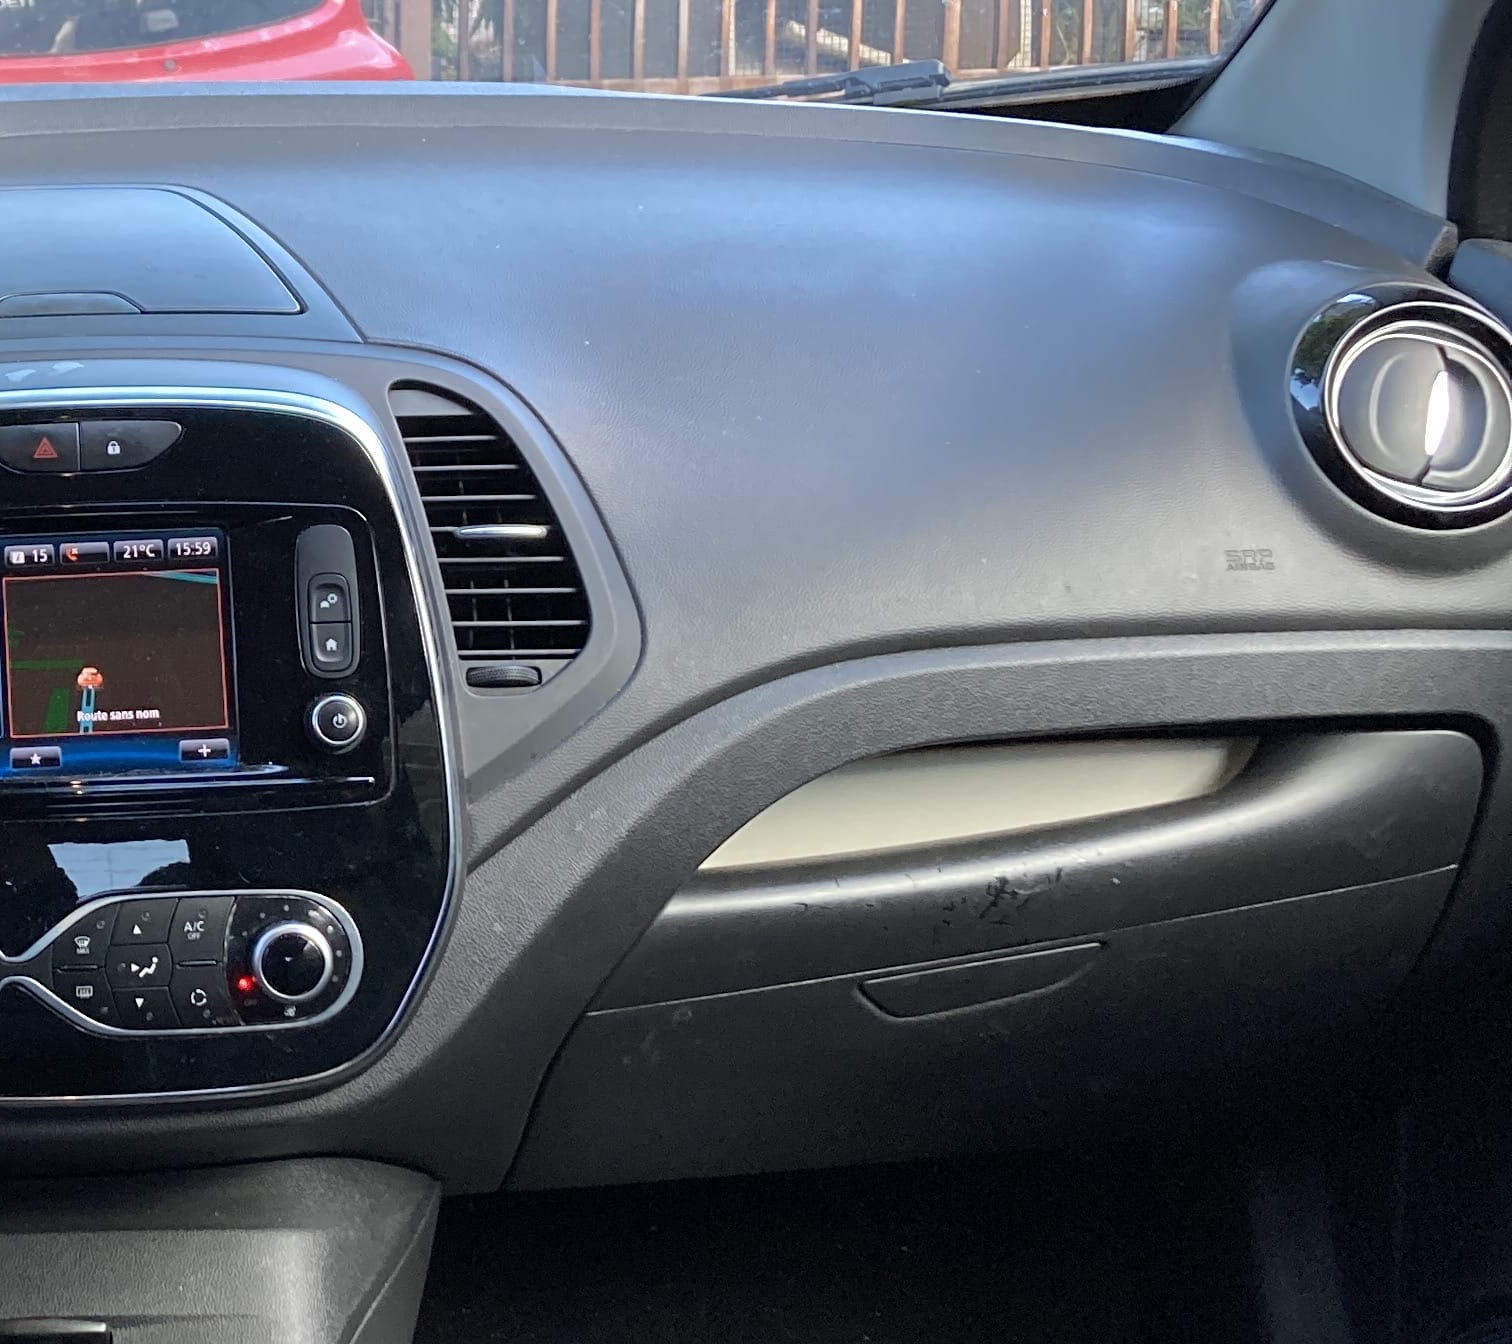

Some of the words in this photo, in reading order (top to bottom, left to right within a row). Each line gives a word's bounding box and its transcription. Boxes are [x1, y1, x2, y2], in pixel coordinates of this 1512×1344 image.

[123, 544, 156, 559] 21°C
[176, 541, 212, 556] 15:59
[32, 549, 48, 563] 15
[77, 710, 108, 722] Route
[109, 710, 134, 721] sans
[136, 709, 160, 720] nom
[184, 920, 206, 932] A/C
[187, 932, 201, 940] OFF
